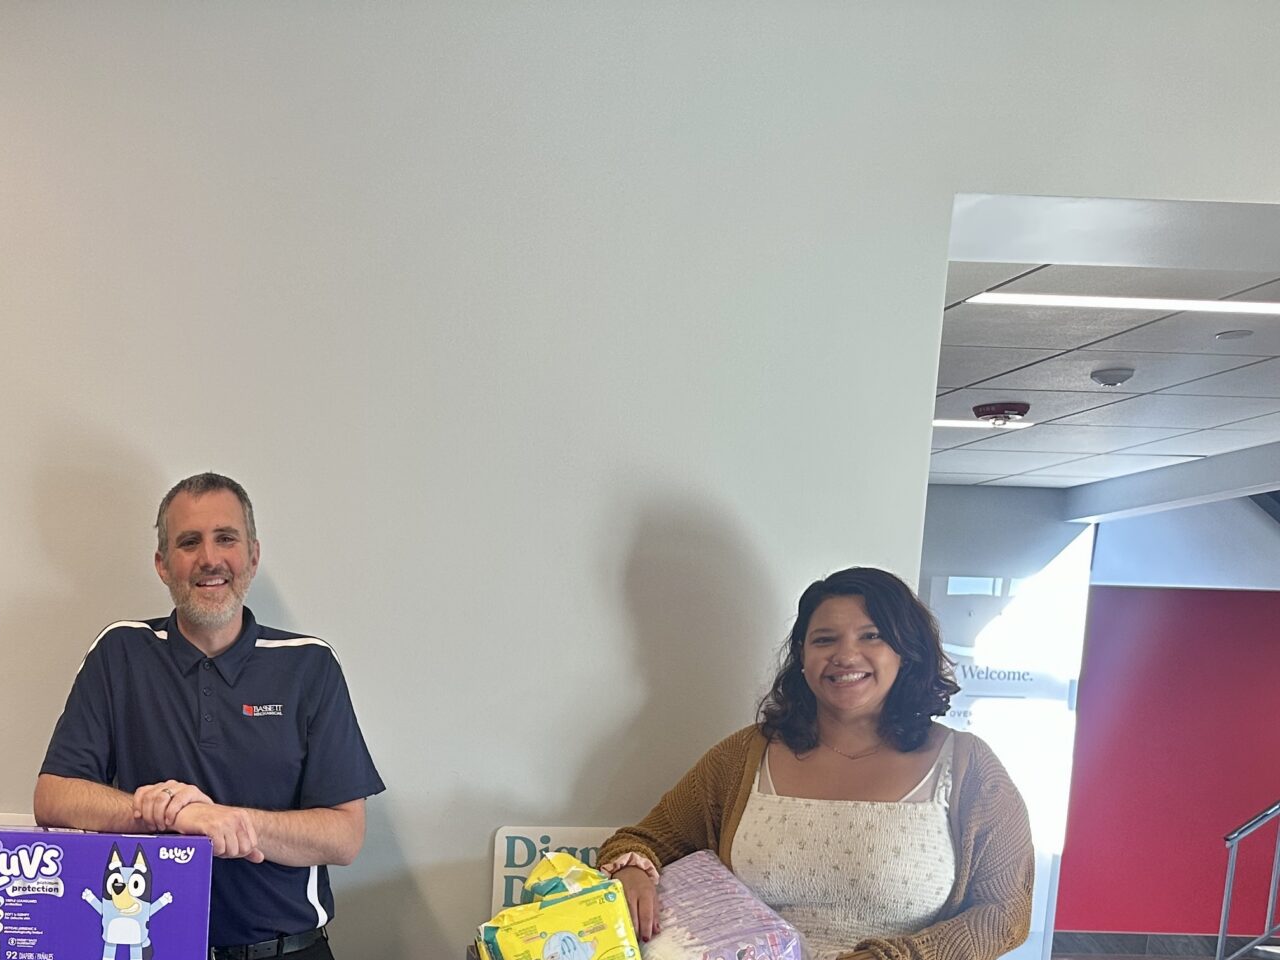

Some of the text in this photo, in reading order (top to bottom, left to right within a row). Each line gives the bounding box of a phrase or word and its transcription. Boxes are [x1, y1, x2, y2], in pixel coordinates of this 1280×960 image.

[961, 665, 1033, 682] Welcome.
[11, 885, 59, 893] protection
[6, 951, 17, 960] 92
